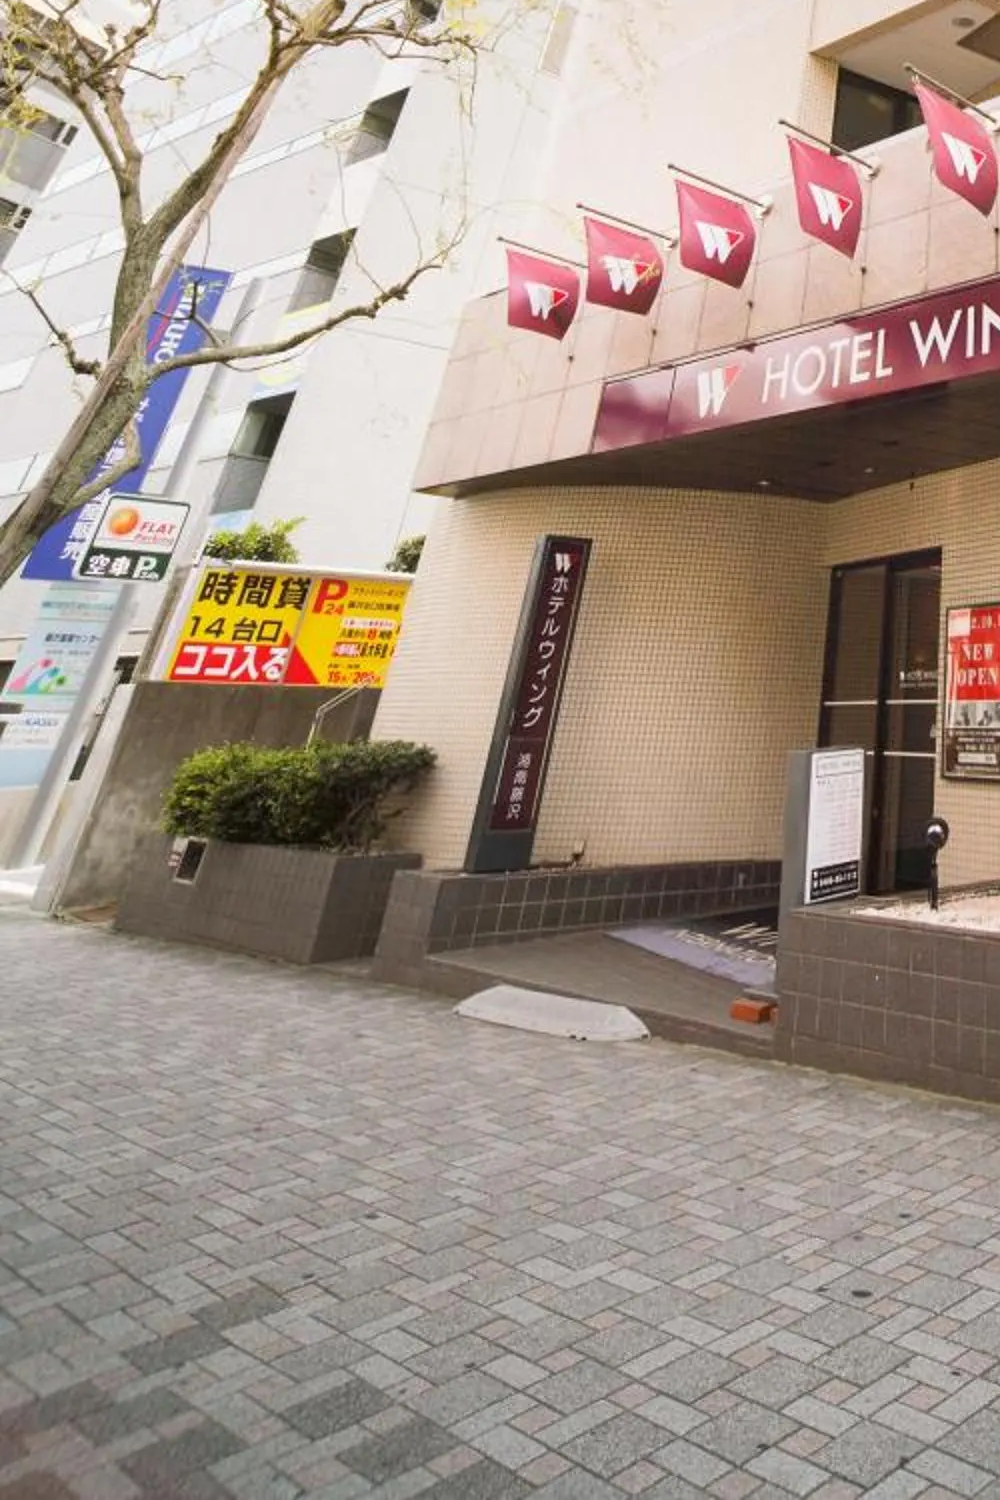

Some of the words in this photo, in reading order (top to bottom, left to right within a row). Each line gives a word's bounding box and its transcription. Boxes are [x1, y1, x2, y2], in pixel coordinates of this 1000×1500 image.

[761, 328, 893, 405] HOTEL
[140, 520, 177, 534] FLAT
[84, 554, 131, 577] 空車
[199, 571, 310, 610] 時間貸
[174, 644, 289, 681] ココ入る
[521, 576, 569, 728] ホテルウィング
[961, 643, 995, 661] NEW
[956, 667, 999, 687] OPEN
